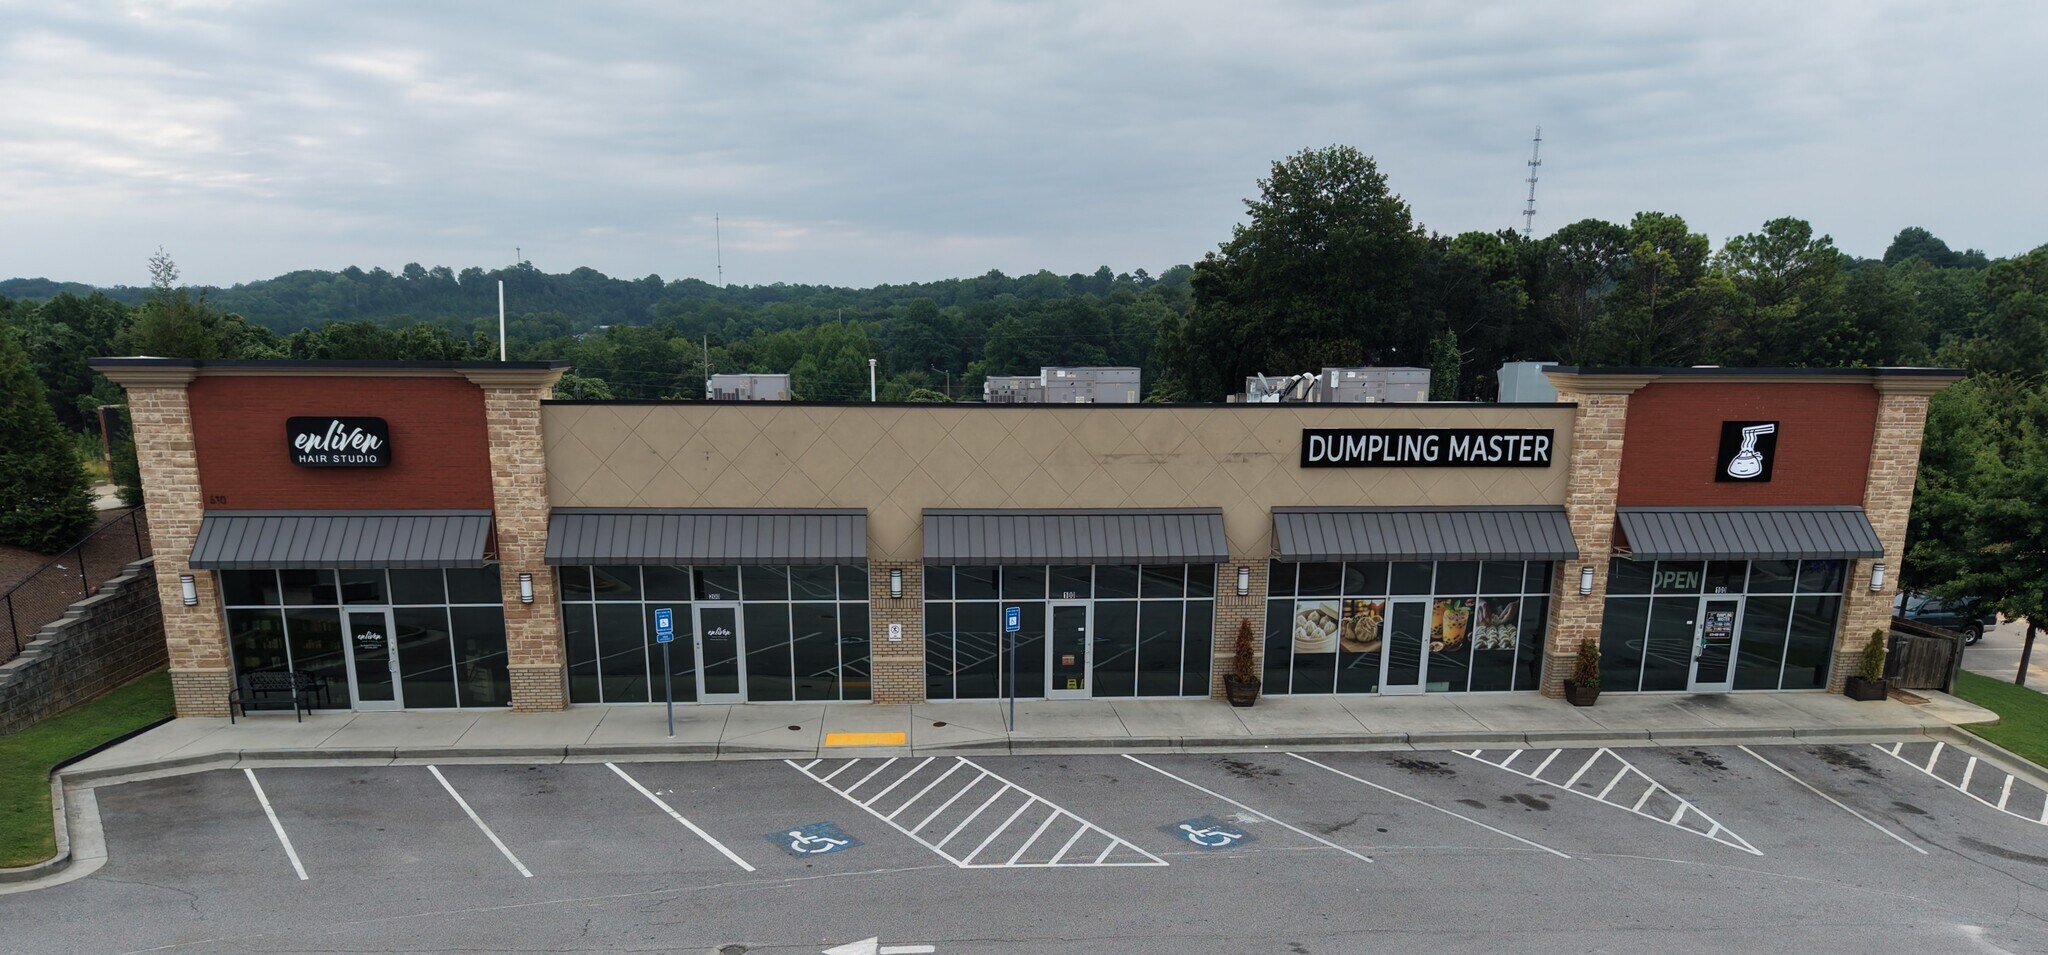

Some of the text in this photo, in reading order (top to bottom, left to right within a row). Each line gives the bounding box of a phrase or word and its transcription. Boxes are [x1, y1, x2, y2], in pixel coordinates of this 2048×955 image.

[294, 419, 383, 454] enliven
[1308, 435, 1550, 462] DUMPLING MASTER
[298, 454, 377, 463] HAIR STUDIO
